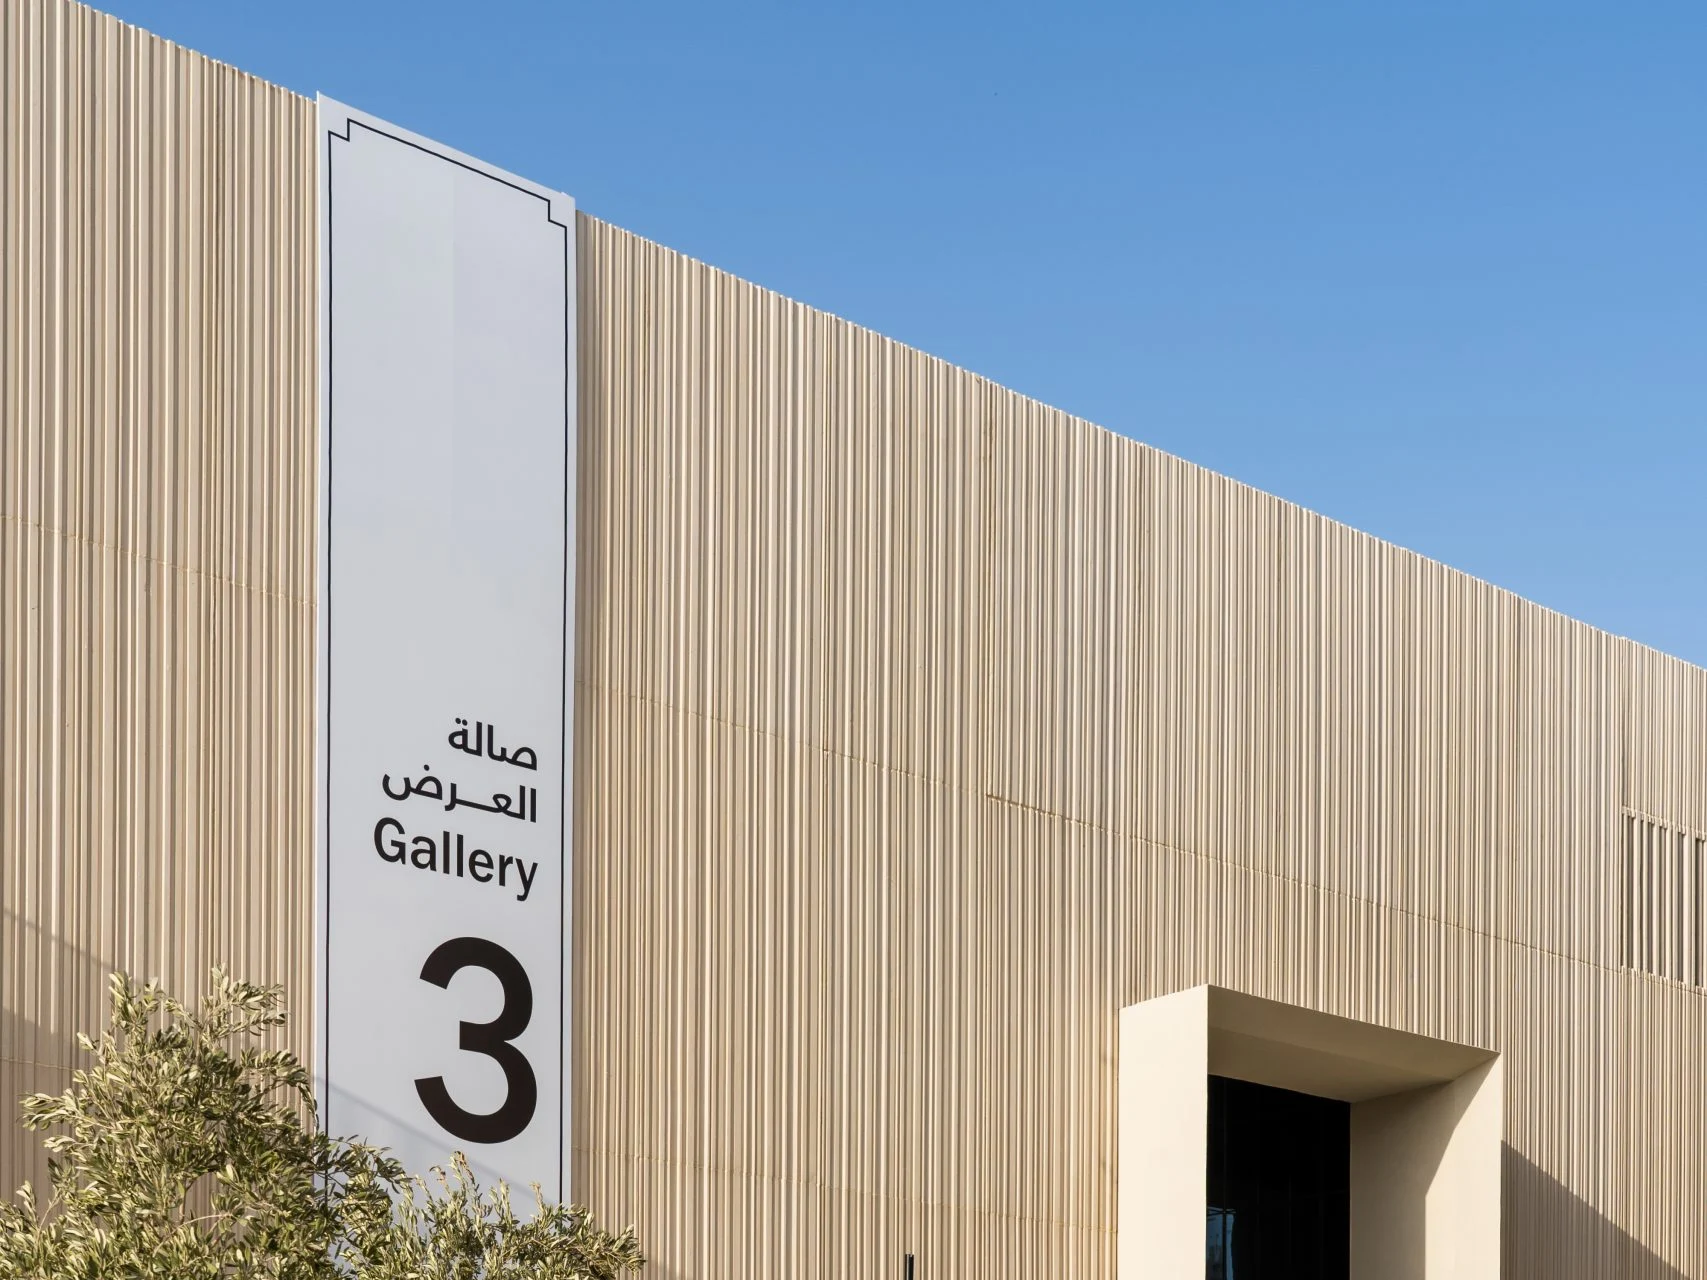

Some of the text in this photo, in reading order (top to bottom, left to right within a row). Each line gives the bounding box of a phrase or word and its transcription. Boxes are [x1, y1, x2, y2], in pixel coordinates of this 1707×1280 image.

[447, 717, 538, 771] صالة
[373, 816, 538, 902] Gallery
[413, 936, 538, 1145] 3
